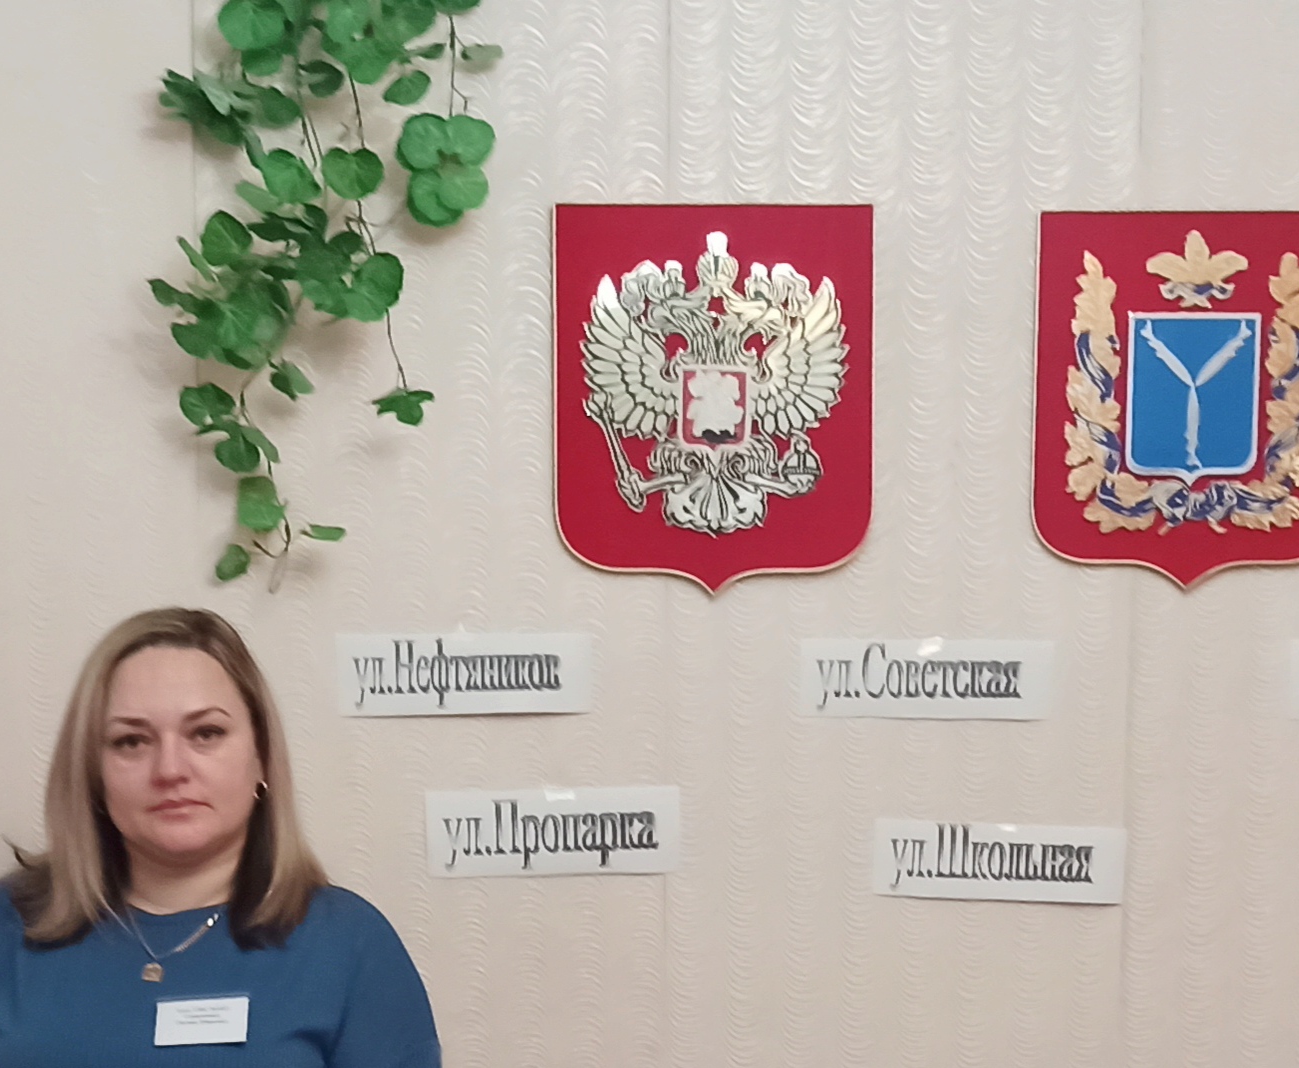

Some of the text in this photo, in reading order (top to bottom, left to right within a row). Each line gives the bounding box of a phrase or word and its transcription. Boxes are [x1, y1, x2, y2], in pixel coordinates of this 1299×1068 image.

[353, 637, 562, 709] ул.Нефтяников
[816, 643, 1023, 711] ул.Советская
[442, 799, 659, 870] ул.Пропарка
[890, 823, 1095, 890] ул.Школьная
